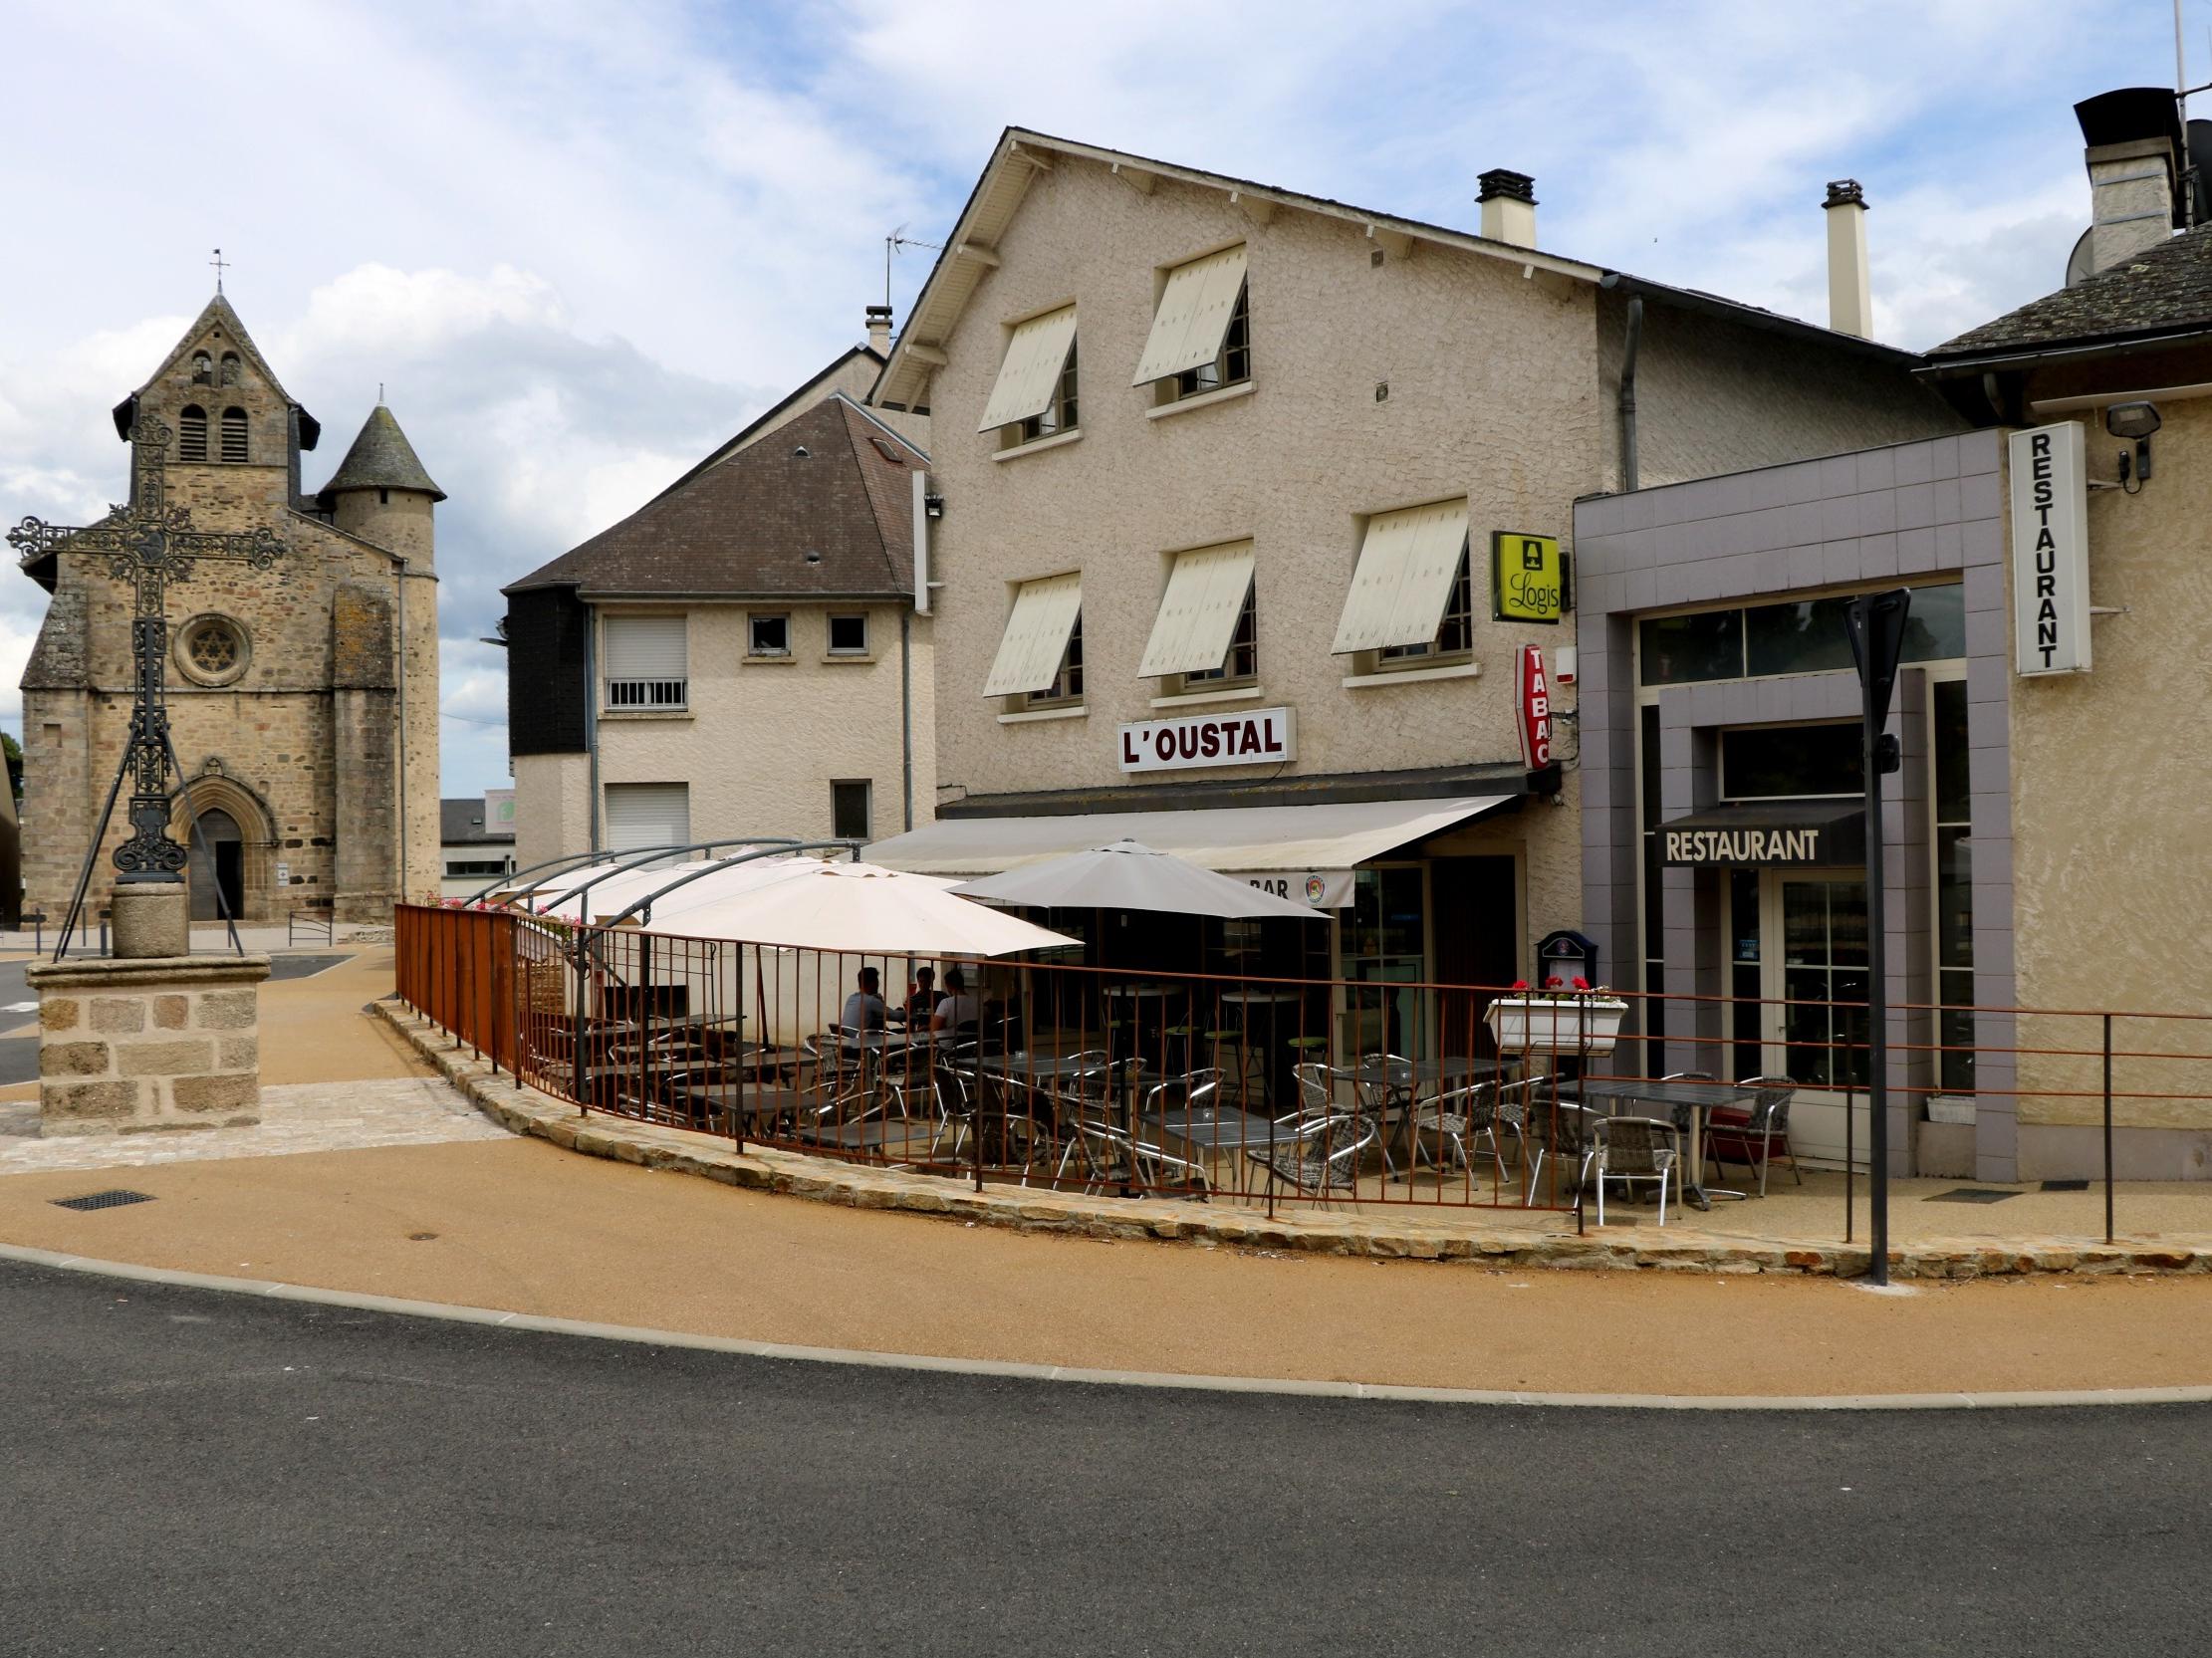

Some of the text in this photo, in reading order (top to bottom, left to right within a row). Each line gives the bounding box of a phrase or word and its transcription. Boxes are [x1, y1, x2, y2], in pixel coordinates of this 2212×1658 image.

[2031, 433, 2059, 668] RESTAURANT
[1509, 572, 1560, 614] Logis
[1530, 649, 1549, 764] TABAC
[1123, 718, 1283, 764] L'OUSTAL
[1666, 829, 1819, 861] RESTAURANT
